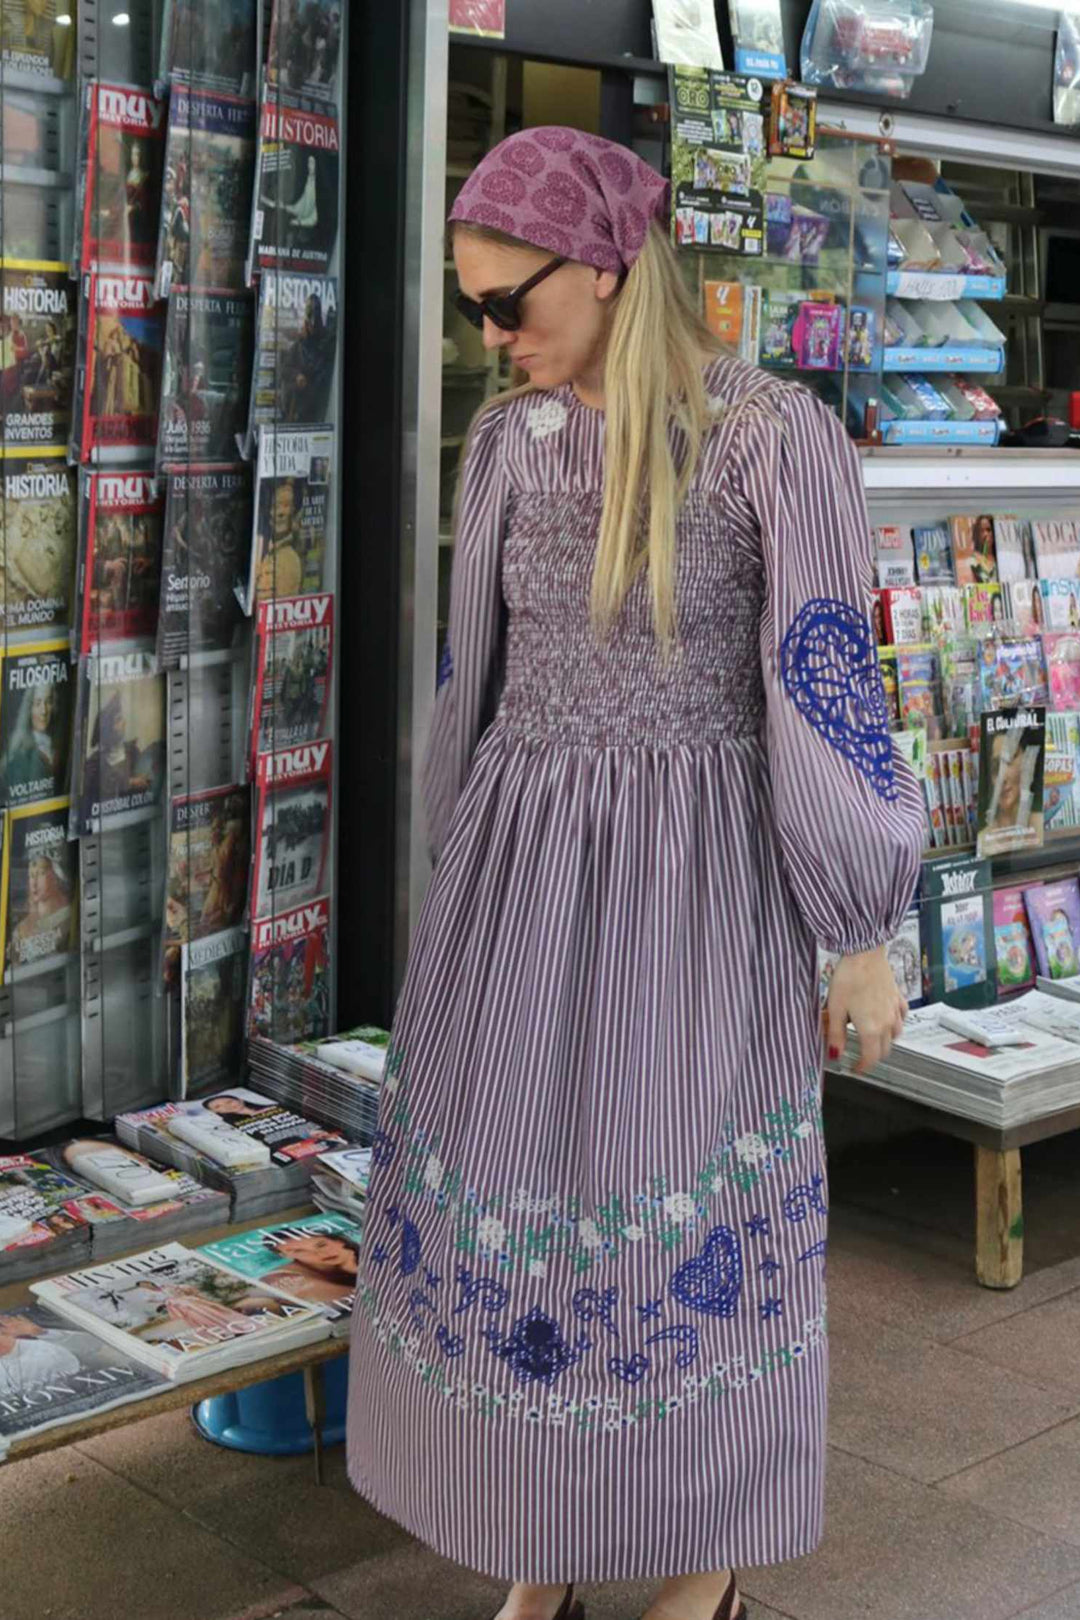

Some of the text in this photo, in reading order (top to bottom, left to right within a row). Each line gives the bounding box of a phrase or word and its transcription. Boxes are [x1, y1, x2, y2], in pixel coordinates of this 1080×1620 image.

[98, 88, 161, 129] muy
[677, 86, 709, 109] ORO
[264, 112, 338, 151] HISTORIA
[291, 248, 301, 258] DE
[4, 286, 68, 314] HISTORIA
[265, 275, 337, 311] HISTORIA
[6, 411, 54, 426] GRANDES
[4, 427, 53, 440] INVENTOS
[263, 434, 309, 454] HISTORIA
[5, 473, 70, 499] HISTORIA
[98, 477, 158, 504] muy
[173, 476, 218, 490] DESPERTA
[168, 573, 211, 591] Sertorio
[18, 609, 55, 625] MUNDO
[266, 597, 329, 626] muy
[266, 743, 329, 775] muy
[9, 776, 55, 798] VOLTAIRE
[25, 824, 66, 848] HISTORIA
[268, 855, 312, 890] DÍA D
[941, 870, 978, 897] Astérix
[259, 904, 321, 946] muy
[67, 1250, 176, 1288] living
